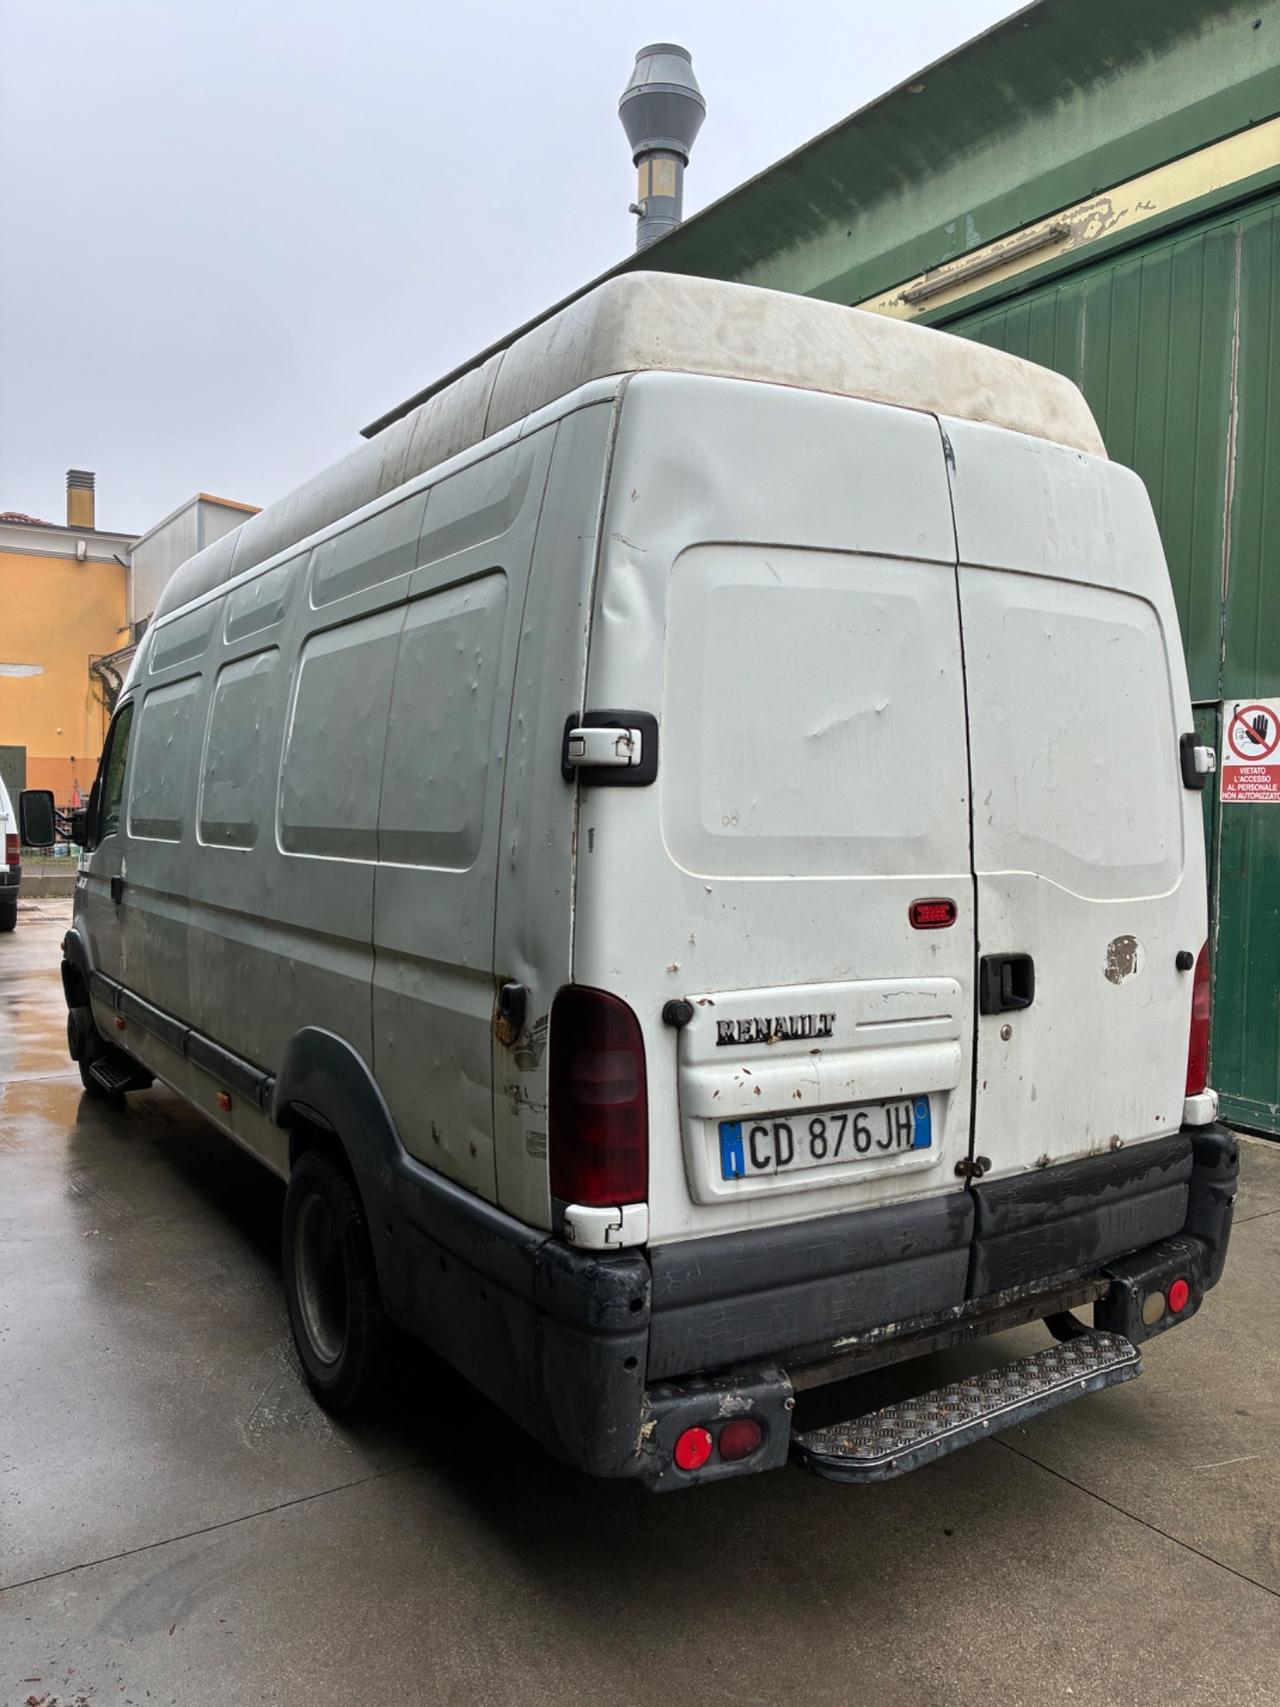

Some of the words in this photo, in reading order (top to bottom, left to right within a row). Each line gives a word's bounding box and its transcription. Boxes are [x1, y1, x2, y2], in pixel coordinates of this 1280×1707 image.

[1227, 783, 1236, 791] AL
[1237, 783, 1278, 791] PERSONALE
[1234, 775, 1271, 783] L'ACCESSO
[716, 1013, 835, 1046] RENAULT
[750, 1123, 794, 1169] CD
[809, 1106, 912, 1159] 876JH
